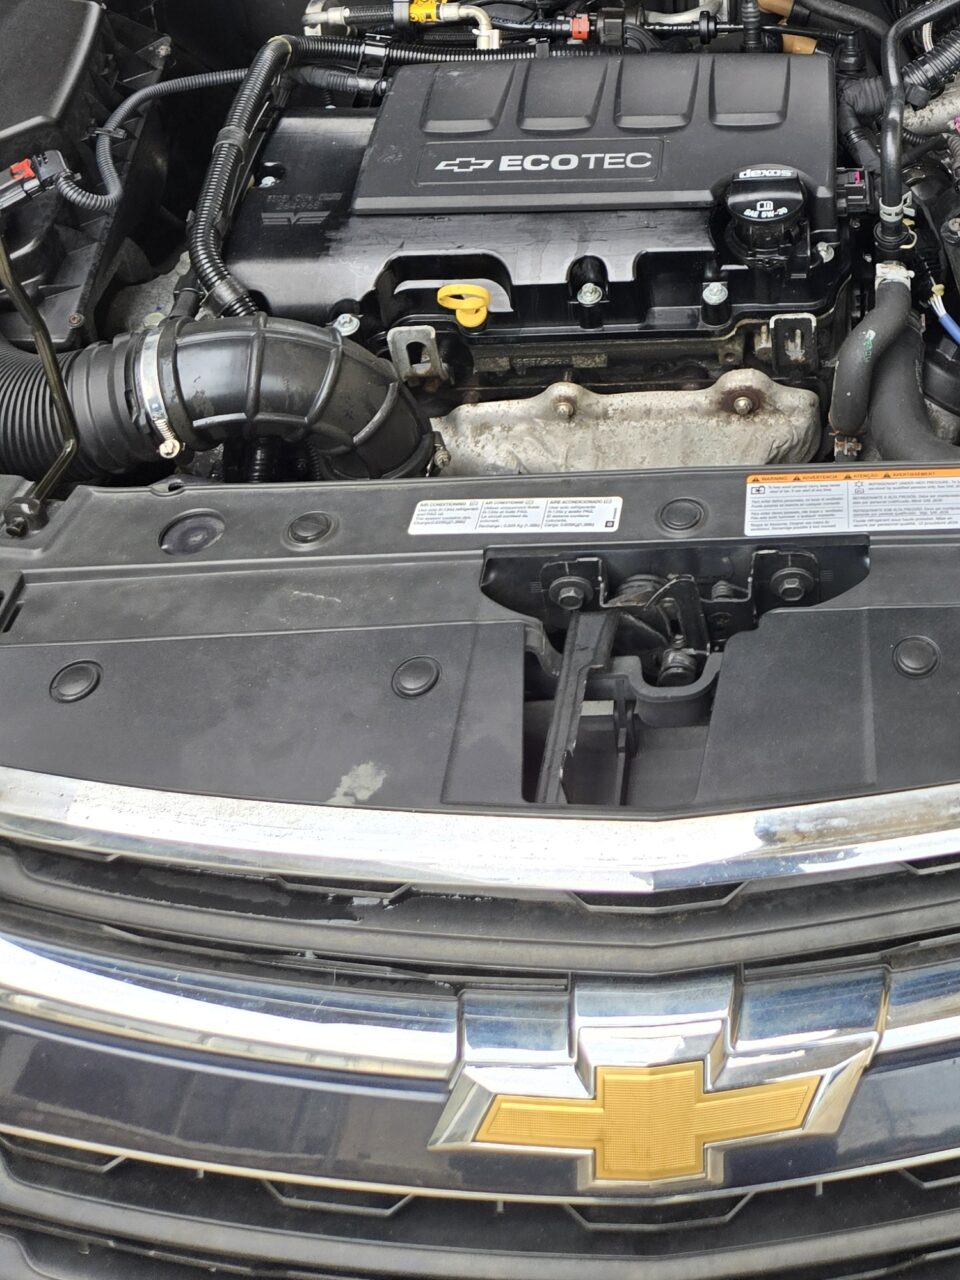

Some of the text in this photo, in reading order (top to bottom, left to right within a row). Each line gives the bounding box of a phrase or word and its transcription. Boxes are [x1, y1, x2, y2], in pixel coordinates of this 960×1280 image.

[498, 151, 653, 172] ECOTEC
[739, 169, 794, 179] dexos
[743, 208, 760, 218] SAE
